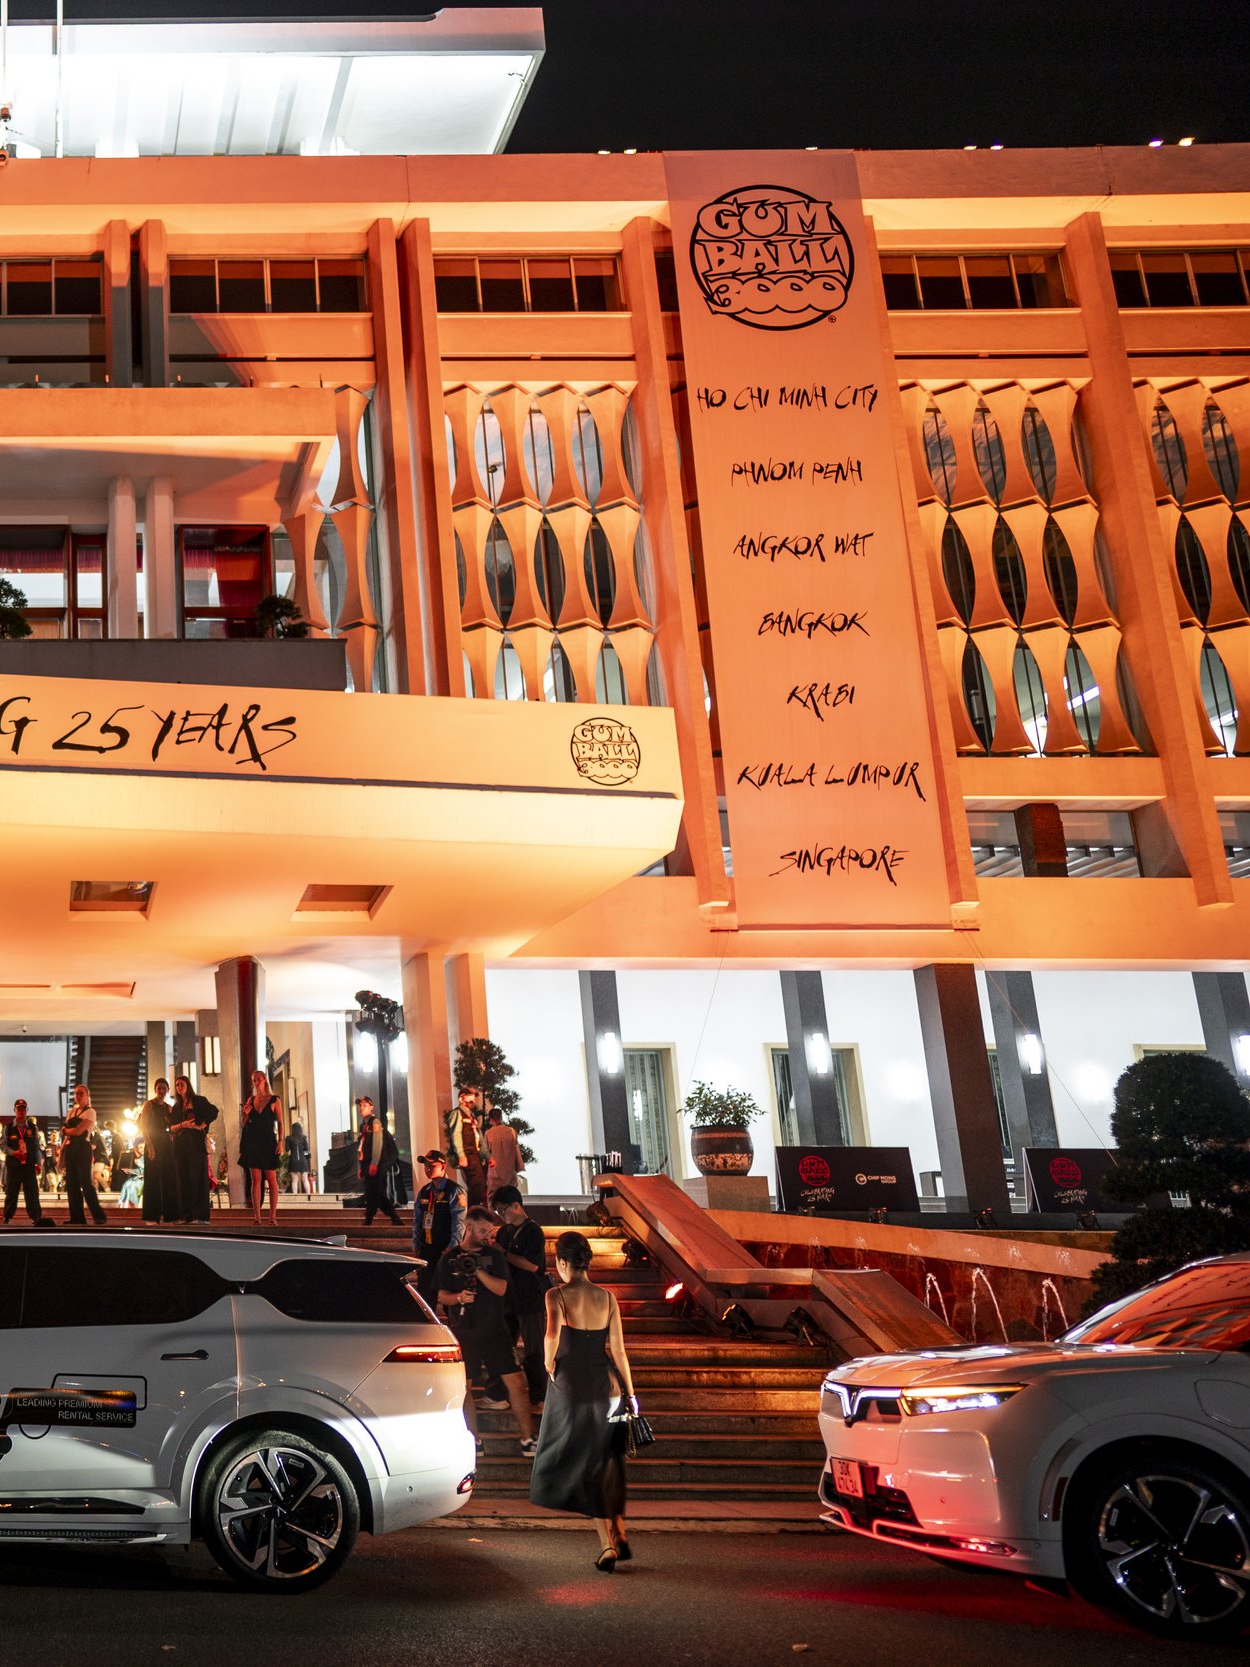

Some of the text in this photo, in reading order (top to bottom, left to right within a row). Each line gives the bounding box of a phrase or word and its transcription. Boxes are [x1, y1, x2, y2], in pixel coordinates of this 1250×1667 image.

[697, 197, 840, 238] GUM
[697, 237, 847, 278] BALL
[703, 276, 848, 315] 3000
[696, 384, 879, 413] HO CHI MINH CITY
[731, 457, 863, 487] PHNOM PENH
[733, 531, 875, 563] ANGKOR WAT
[757, 608, 871, 639] BANGKOK
[786, 682, 856, 722] KRABI
[52, 704, 145, 754] 25
[150, 702, 298, 771] YEARS
[573, 723, 636, 743] GUM
[572, 742, 638, 762] BALL
[577, 760, 639, 779] 3000
[737, 761, 927, 803] KUALA LUMPUR
[768, 842, 910, 887] SINGAPORE
[801, 1159, 826, 1167] GUM
[16, 1398, 103, 1409] LEADING PREMIUM
[58, 1410, 134, 1421] RENTAL SERVICE
